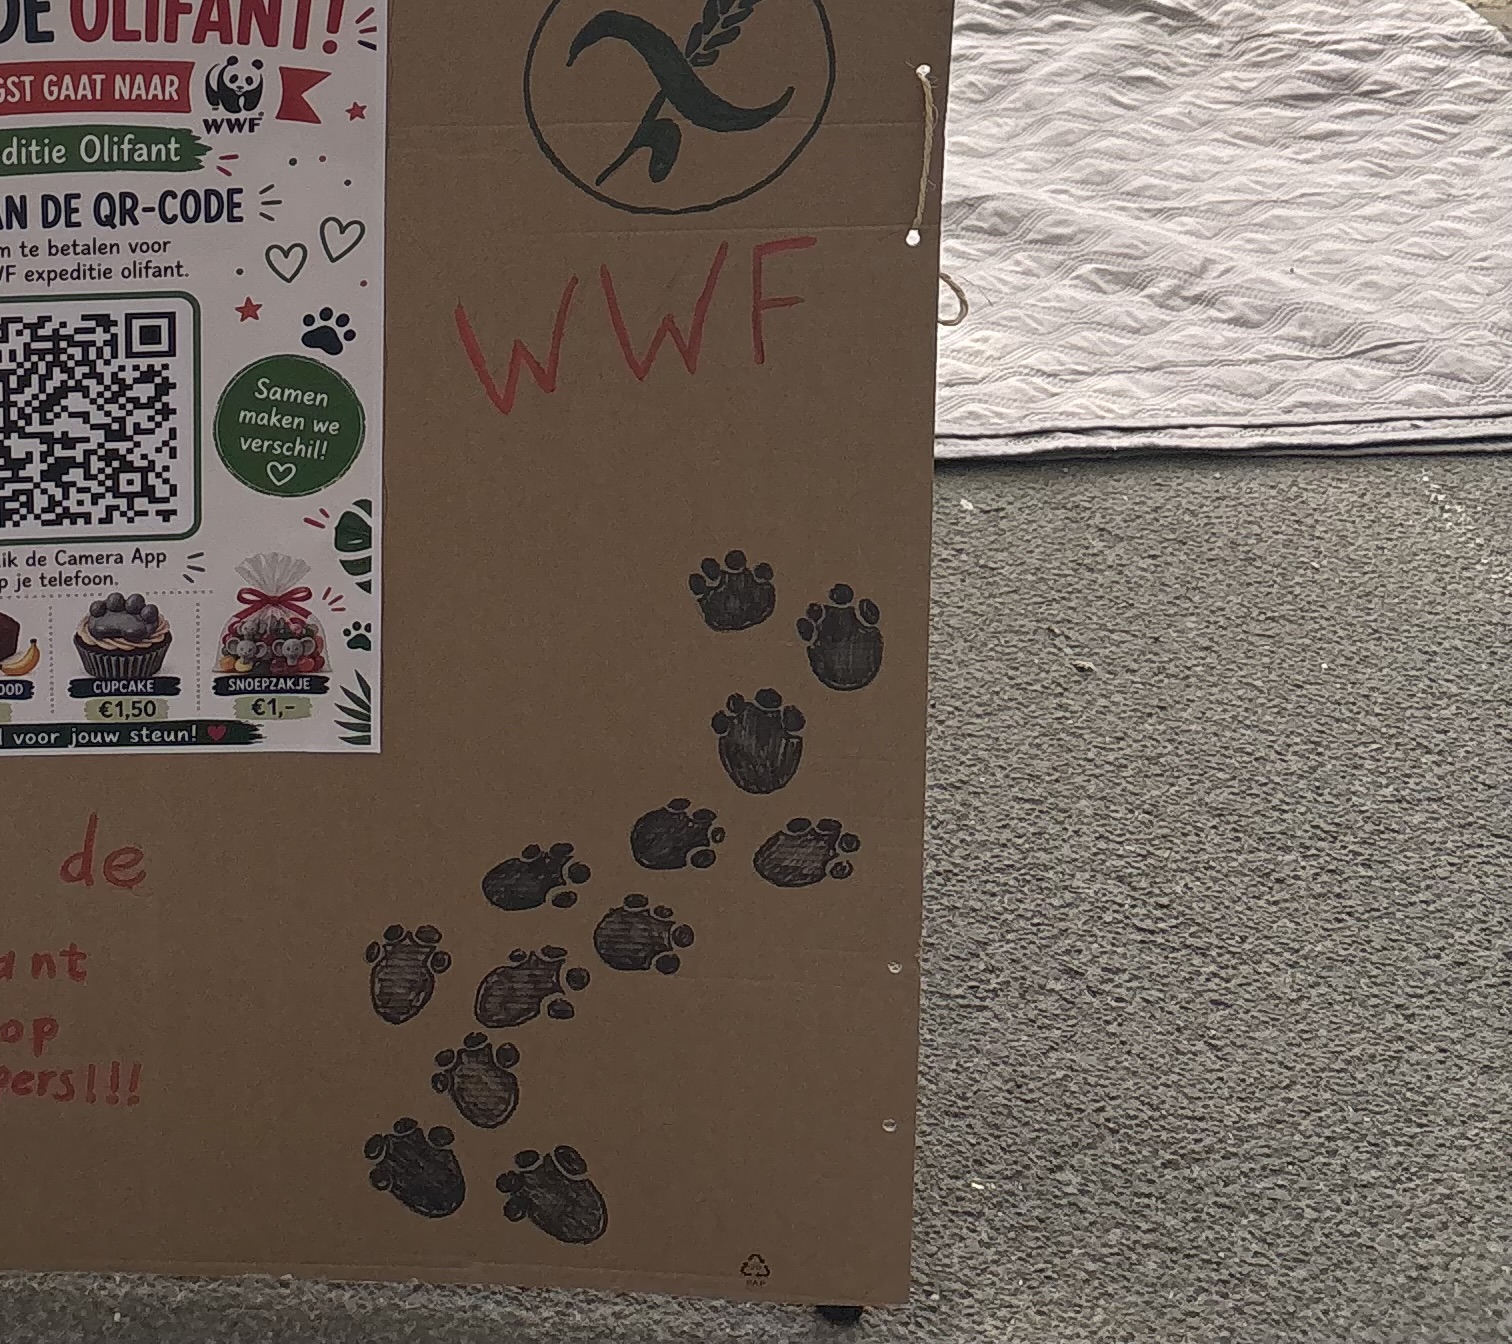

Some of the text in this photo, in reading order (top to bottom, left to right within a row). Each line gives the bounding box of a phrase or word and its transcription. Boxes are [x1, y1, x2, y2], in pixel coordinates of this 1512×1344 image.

[43, 74, 105, 104] GAAT
[114, 73, 180, 102] NAAR
[202, 117, 262, 135] WWF
[79, 134, 182, 165] Olifant
[41, 192, 82, 229] DE
[93, 188, 245, 229] QR-CODE
[19, 239, 40, 258] te
[47, 236, 119, 257] betalen
[122, 238, 172, 255] voor
[23, 261, 114, 287] expeditie
[453, 235, 818, 416] WWF
[253, 377, 329, 409] Samen
[239, 406, 341, 437] maken we
[239, 433, 328, 462] verschil!
[25, 549, 48, 568] de
[54, 547, 123, 567] Camera
[130, 547, 167, 571] App
[13, 571, 34, 592] je
[38, 568, 119, 589] telefoon.
[92, 677, 155, 694] CUPCAKE
[227, 675, 312, 693] SNOEPZAKJE
[98, 699, 157, 719] €1,50
[13, 729, 61, 746] voor
[69, 727, 119, 748] jouw
[129, 724, 197, 744] steun!
[59, 813, 148, 889] de
